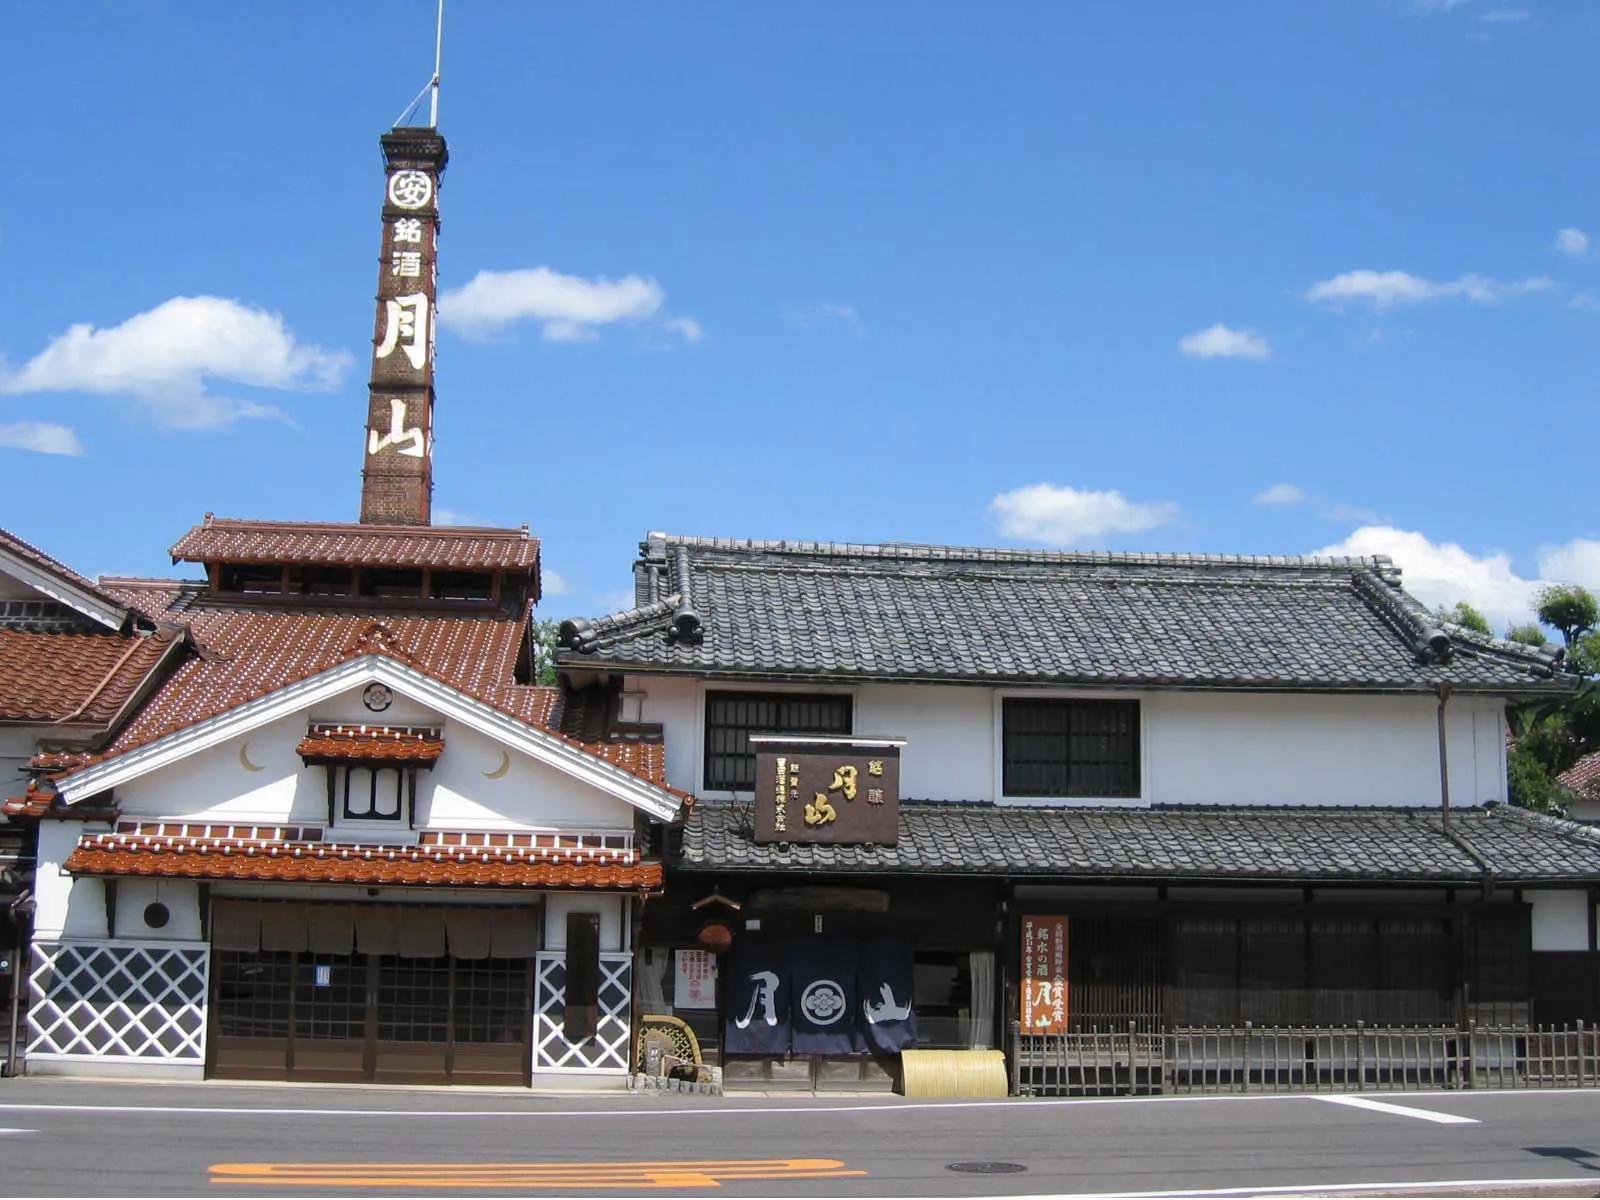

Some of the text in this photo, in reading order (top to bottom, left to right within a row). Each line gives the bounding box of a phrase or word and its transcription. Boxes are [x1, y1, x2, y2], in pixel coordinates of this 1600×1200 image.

[392, 172, 430, 207] 安
[369, 218, 427, 457] 銘酒 月山
[735, 970, 780, 1029] 月
[863, 982, 912, 1025] 山
[1032, 981, 1052, 1027] 月山
